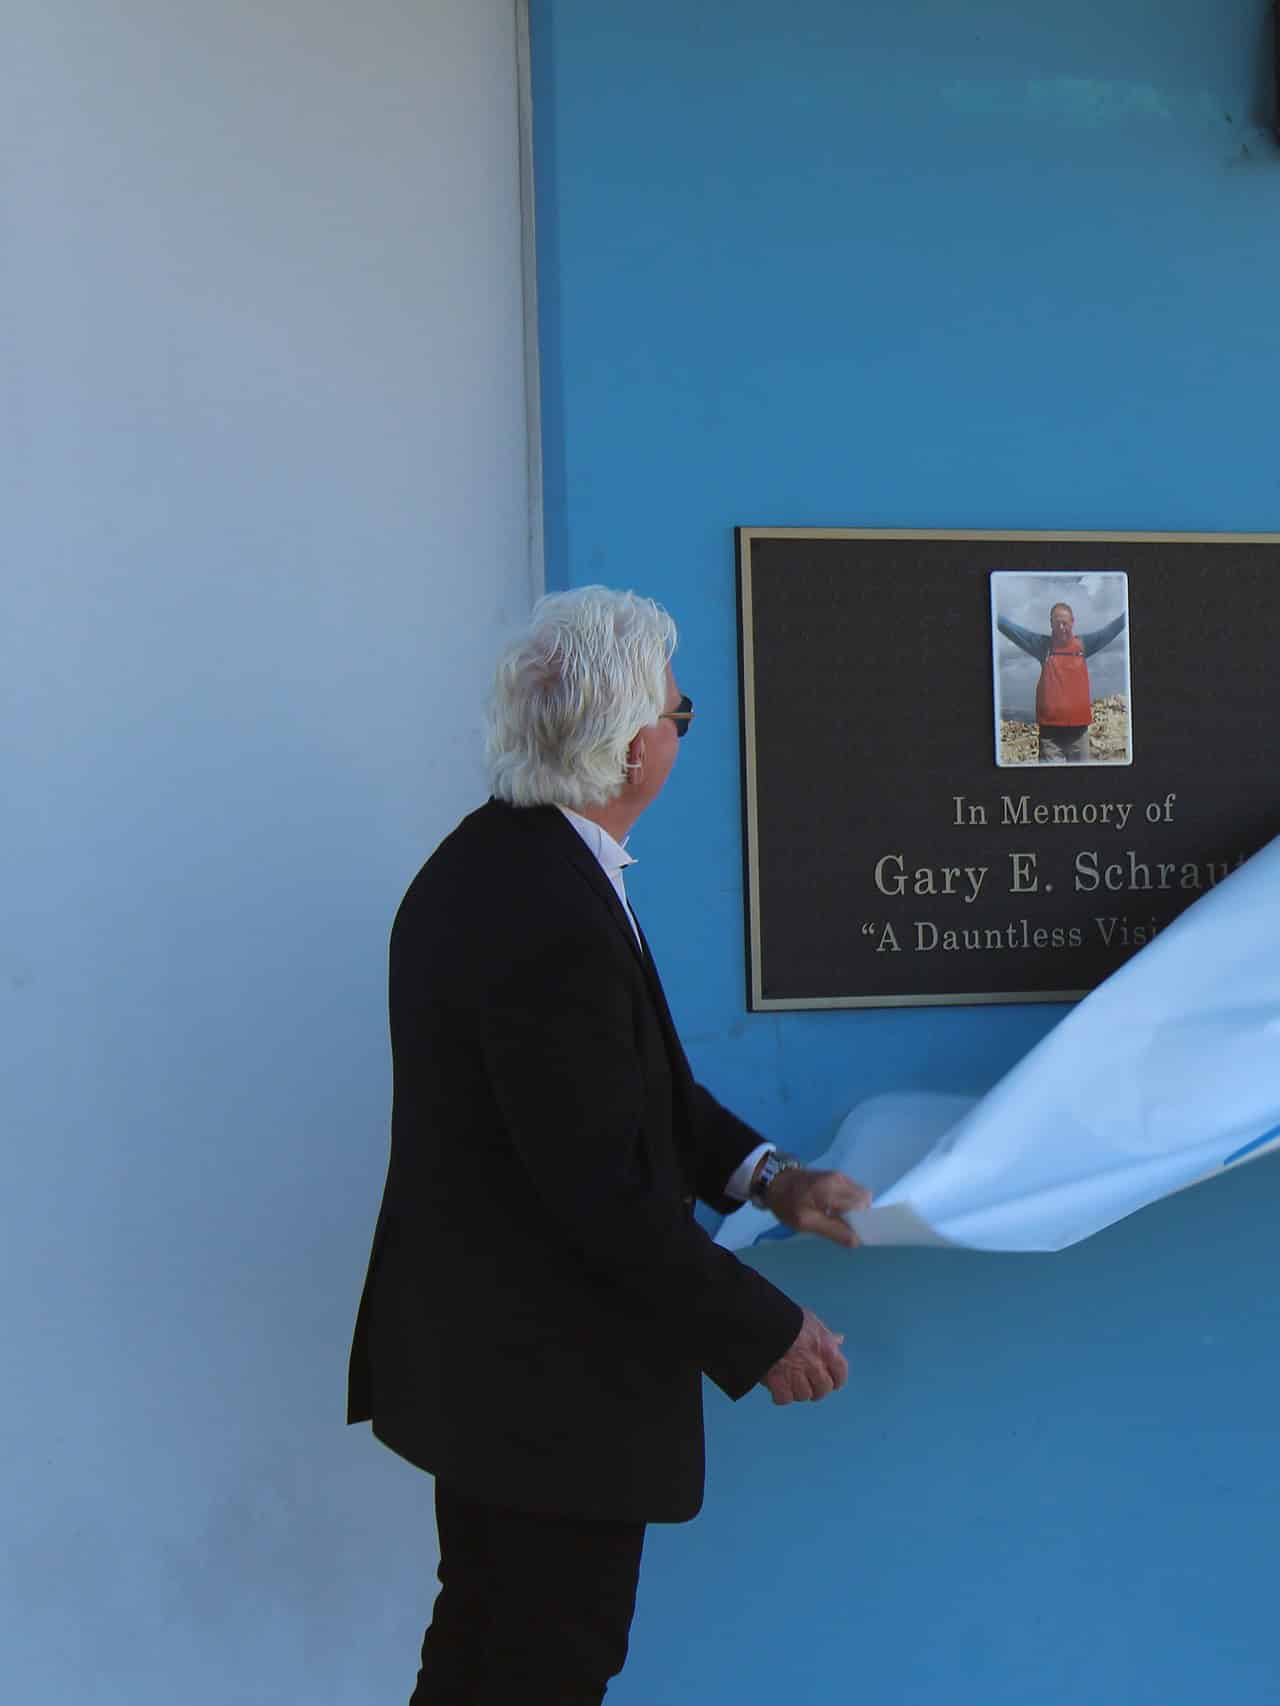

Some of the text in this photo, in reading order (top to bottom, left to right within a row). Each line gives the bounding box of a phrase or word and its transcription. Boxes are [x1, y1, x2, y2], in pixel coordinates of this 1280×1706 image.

[952, 792, 1177, 830] In Memory of
[873, 850, 1245, 903] Gary E. Schrau
[860, 920, 902, 952] “A
[914, 918, 1081, 952] Dauntless
